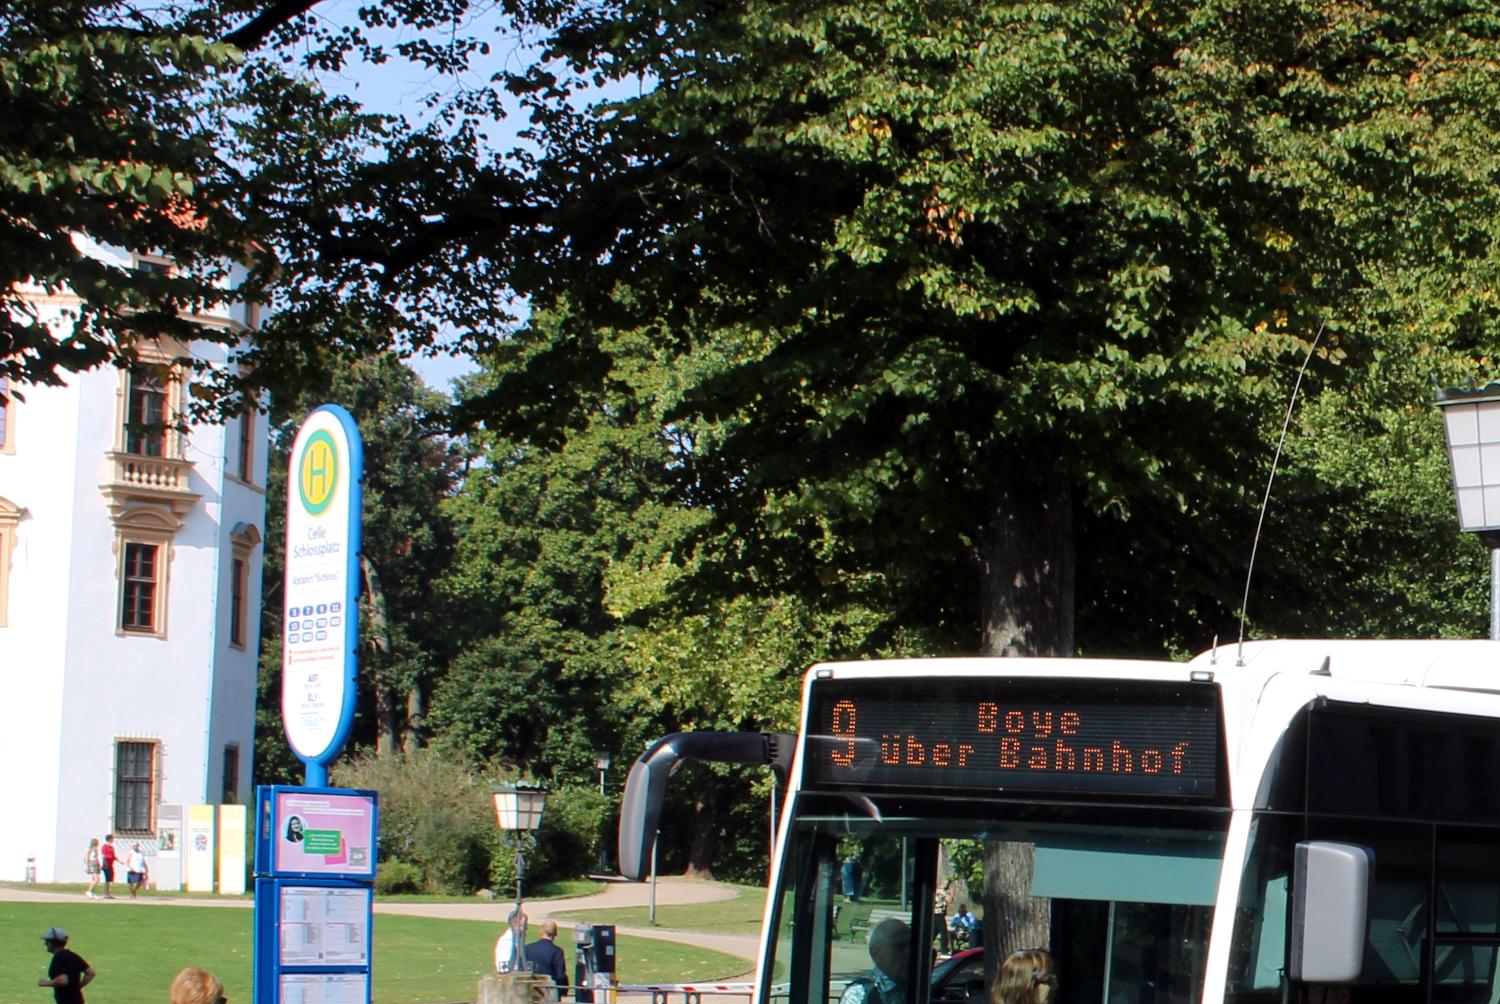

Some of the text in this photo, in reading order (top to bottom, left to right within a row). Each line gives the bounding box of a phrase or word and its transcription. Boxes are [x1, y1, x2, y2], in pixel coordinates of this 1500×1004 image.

[310, 447, 327, 498] H
[293, 541, 341, 559] Schlossplatz
[308, 526, 327, 540] Celle
[831, 699, 1081, 768] 9 Boye
[880, 733, 1190, 775] über Bahnhof
